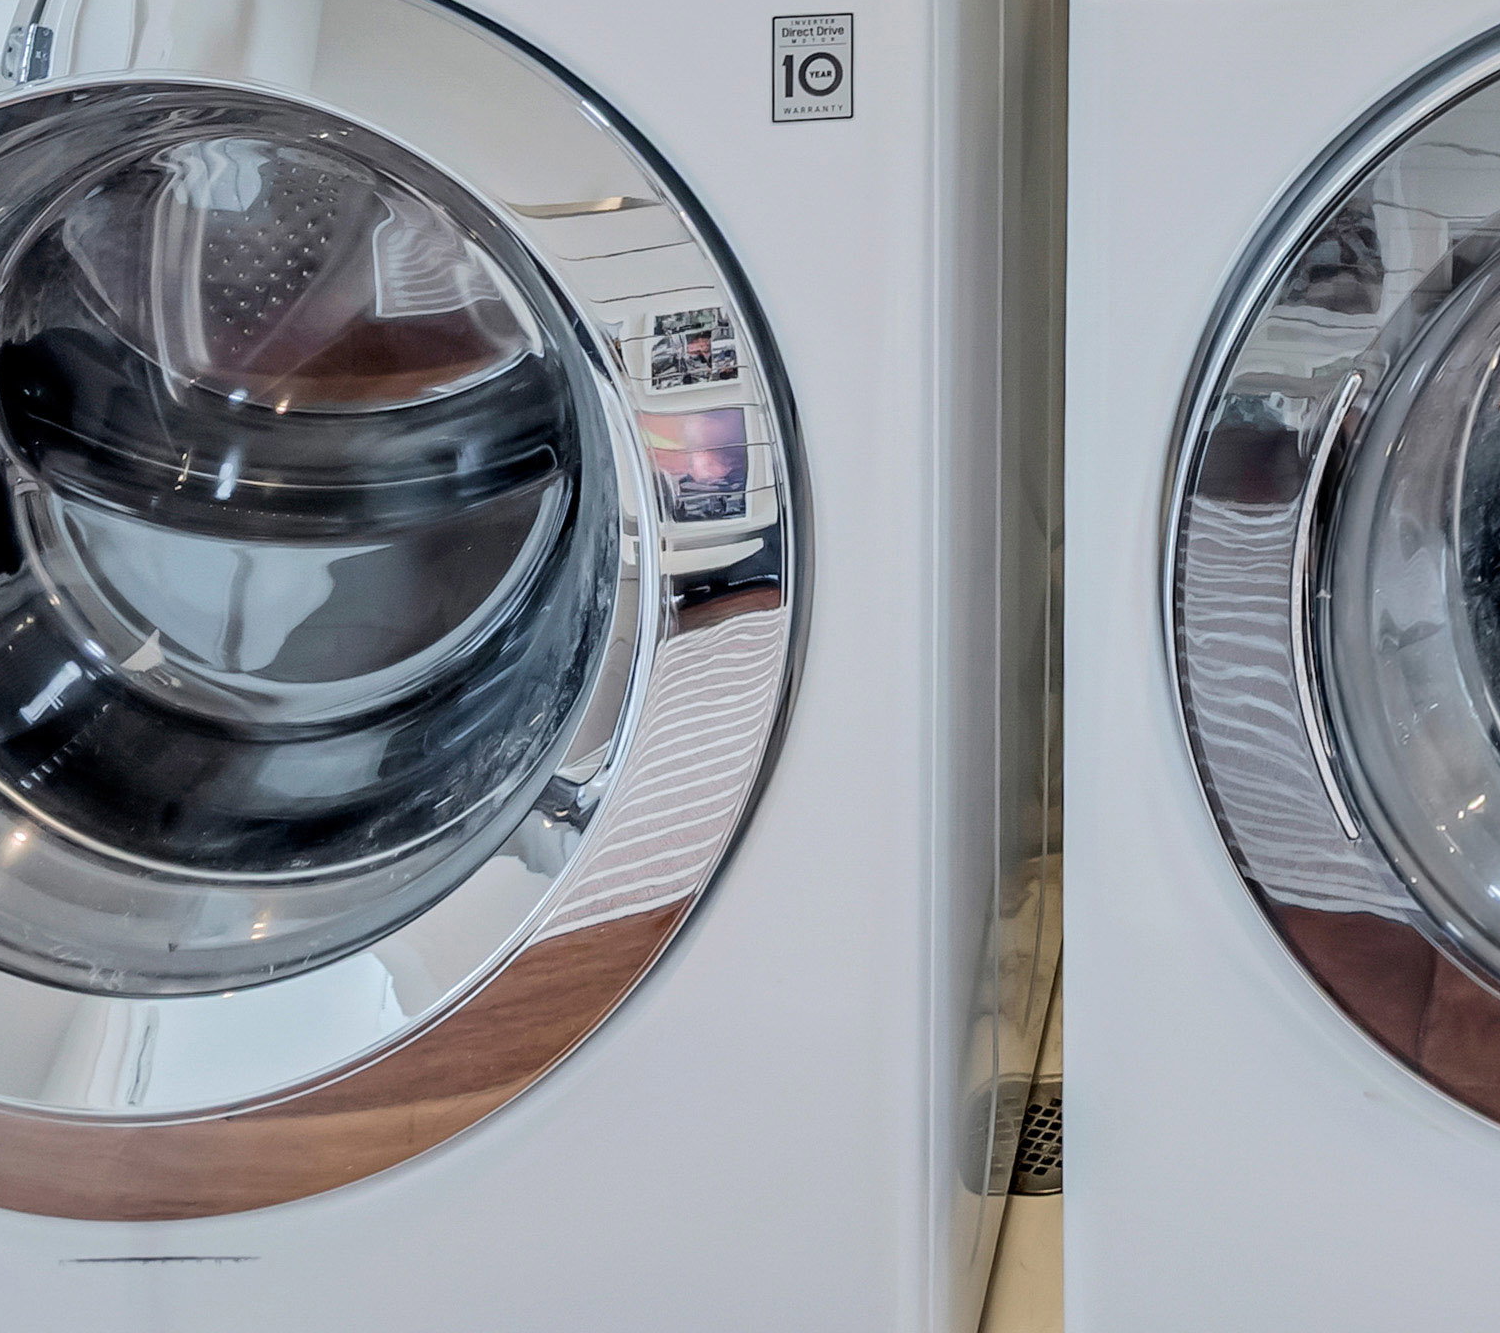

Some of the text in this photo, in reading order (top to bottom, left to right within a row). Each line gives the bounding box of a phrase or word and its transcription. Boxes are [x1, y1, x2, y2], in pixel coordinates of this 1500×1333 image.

[782, 26, 844, 37] Direct Drive
[782, 52, 843, 98] 10
[783, 105, 844, 114] WARRANTY
